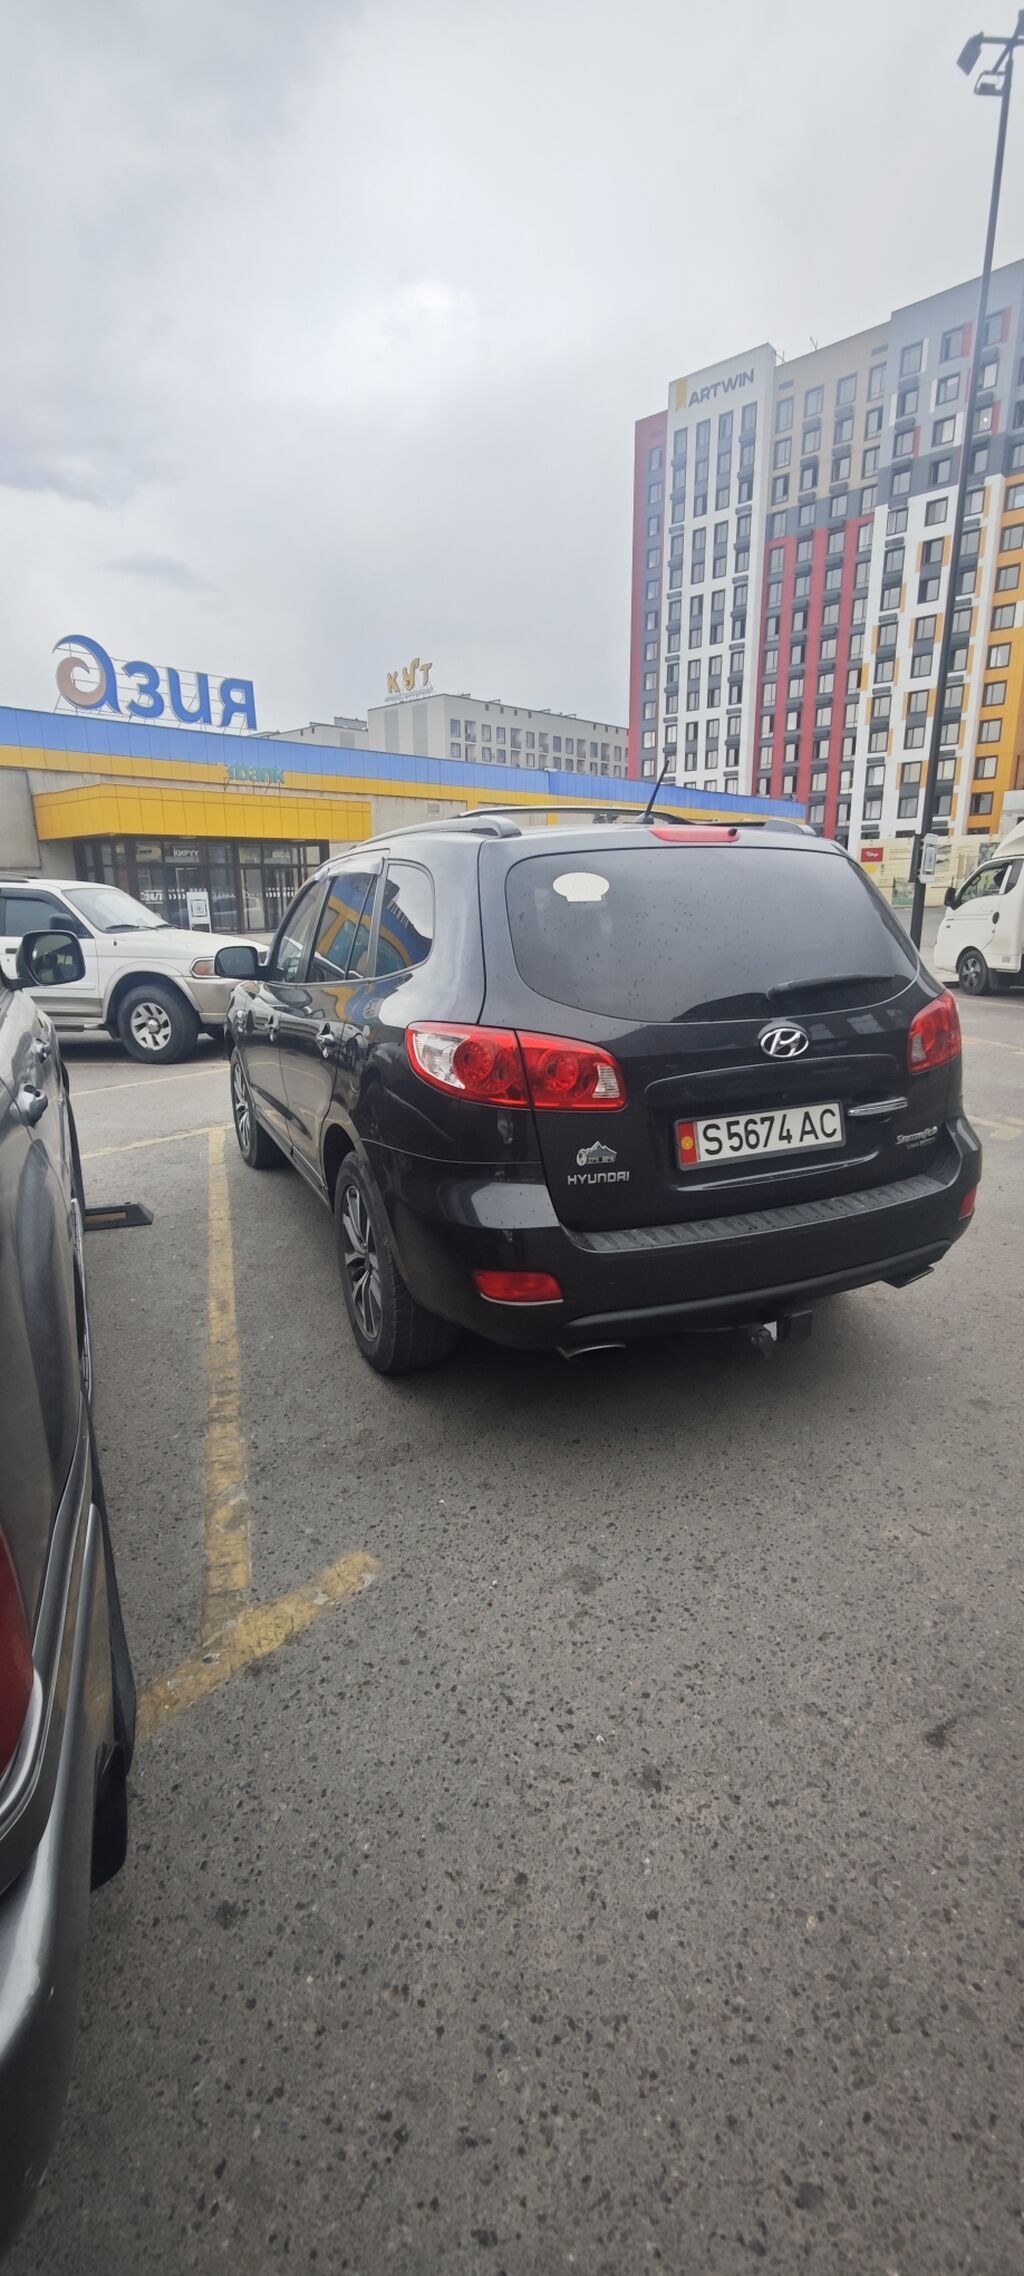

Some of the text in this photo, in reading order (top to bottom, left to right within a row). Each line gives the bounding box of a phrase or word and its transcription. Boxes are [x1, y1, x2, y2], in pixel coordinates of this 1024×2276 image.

[687, 368, 755, 408] ARTWIN
[702, 1108, 838, 1156] S5674 AC
[567, 1171, 630, 1185] HYUNDAI
